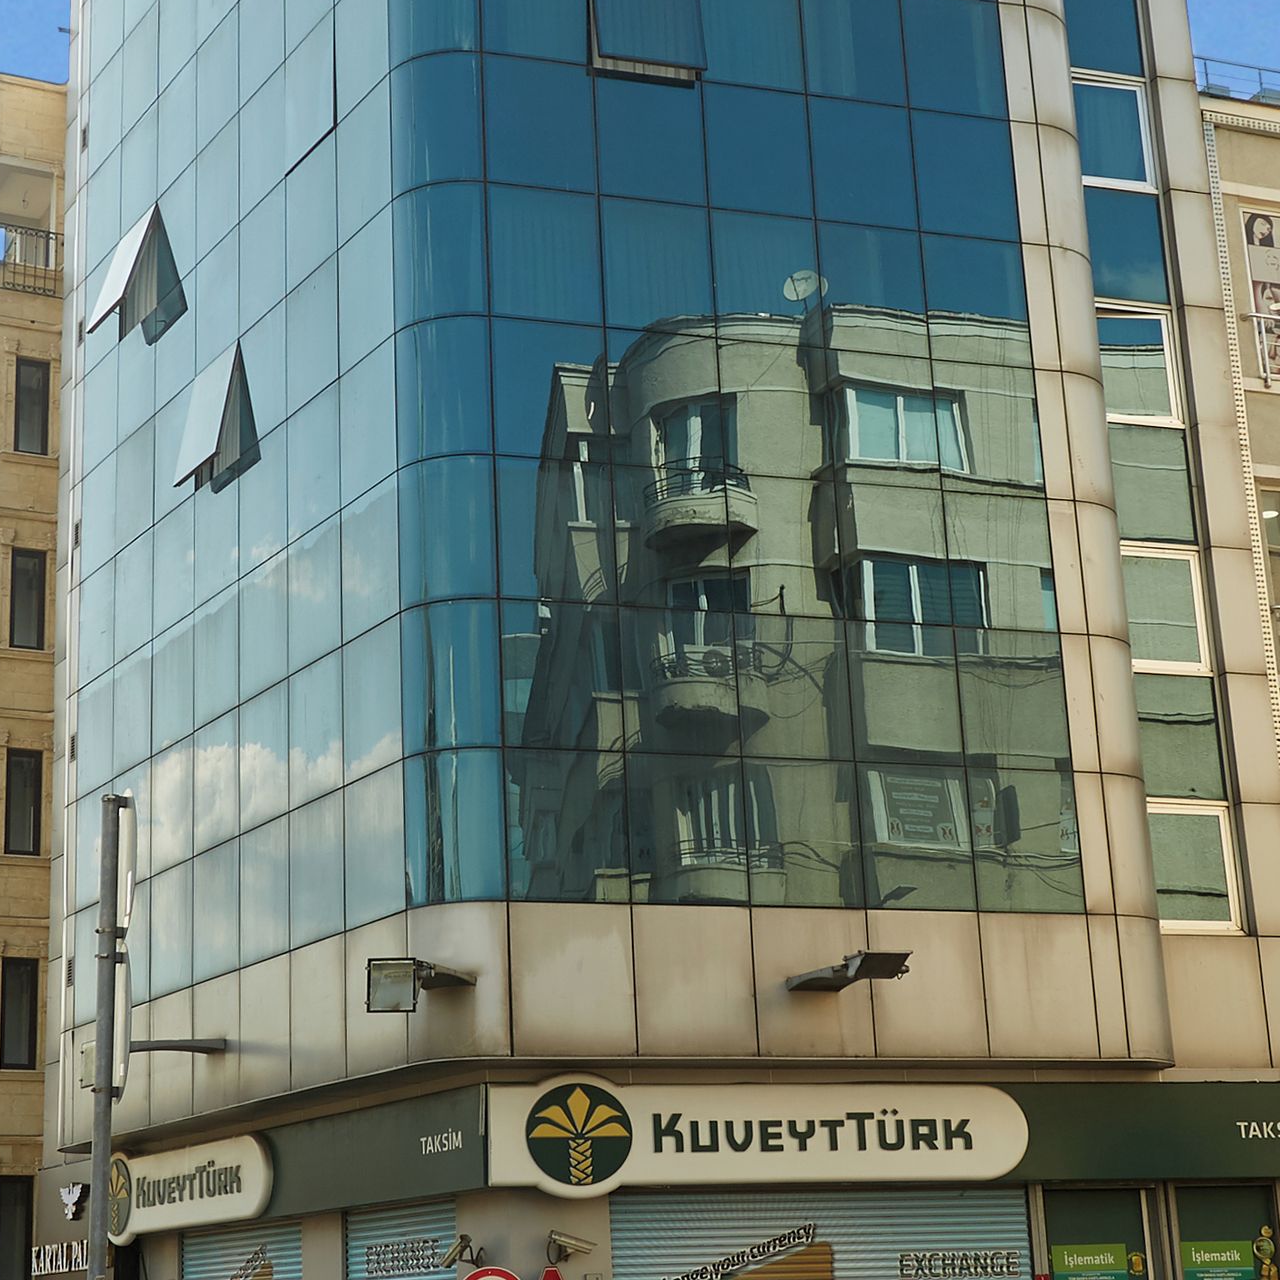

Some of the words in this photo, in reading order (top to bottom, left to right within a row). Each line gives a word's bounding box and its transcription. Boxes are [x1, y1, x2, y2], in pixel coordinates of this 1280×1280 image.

[420, 1128, 463, 1155] TAKSİM
[31, 1246, 70, 1276] KARTAL
[71, 1240, 90, 1270] PAL
[898, 1250, 1020, 1279] EXCHANGE
[1063, 1250, 1115, 1266] İşlematik
[1192, 1247, 1241, 1263] İşlematik
